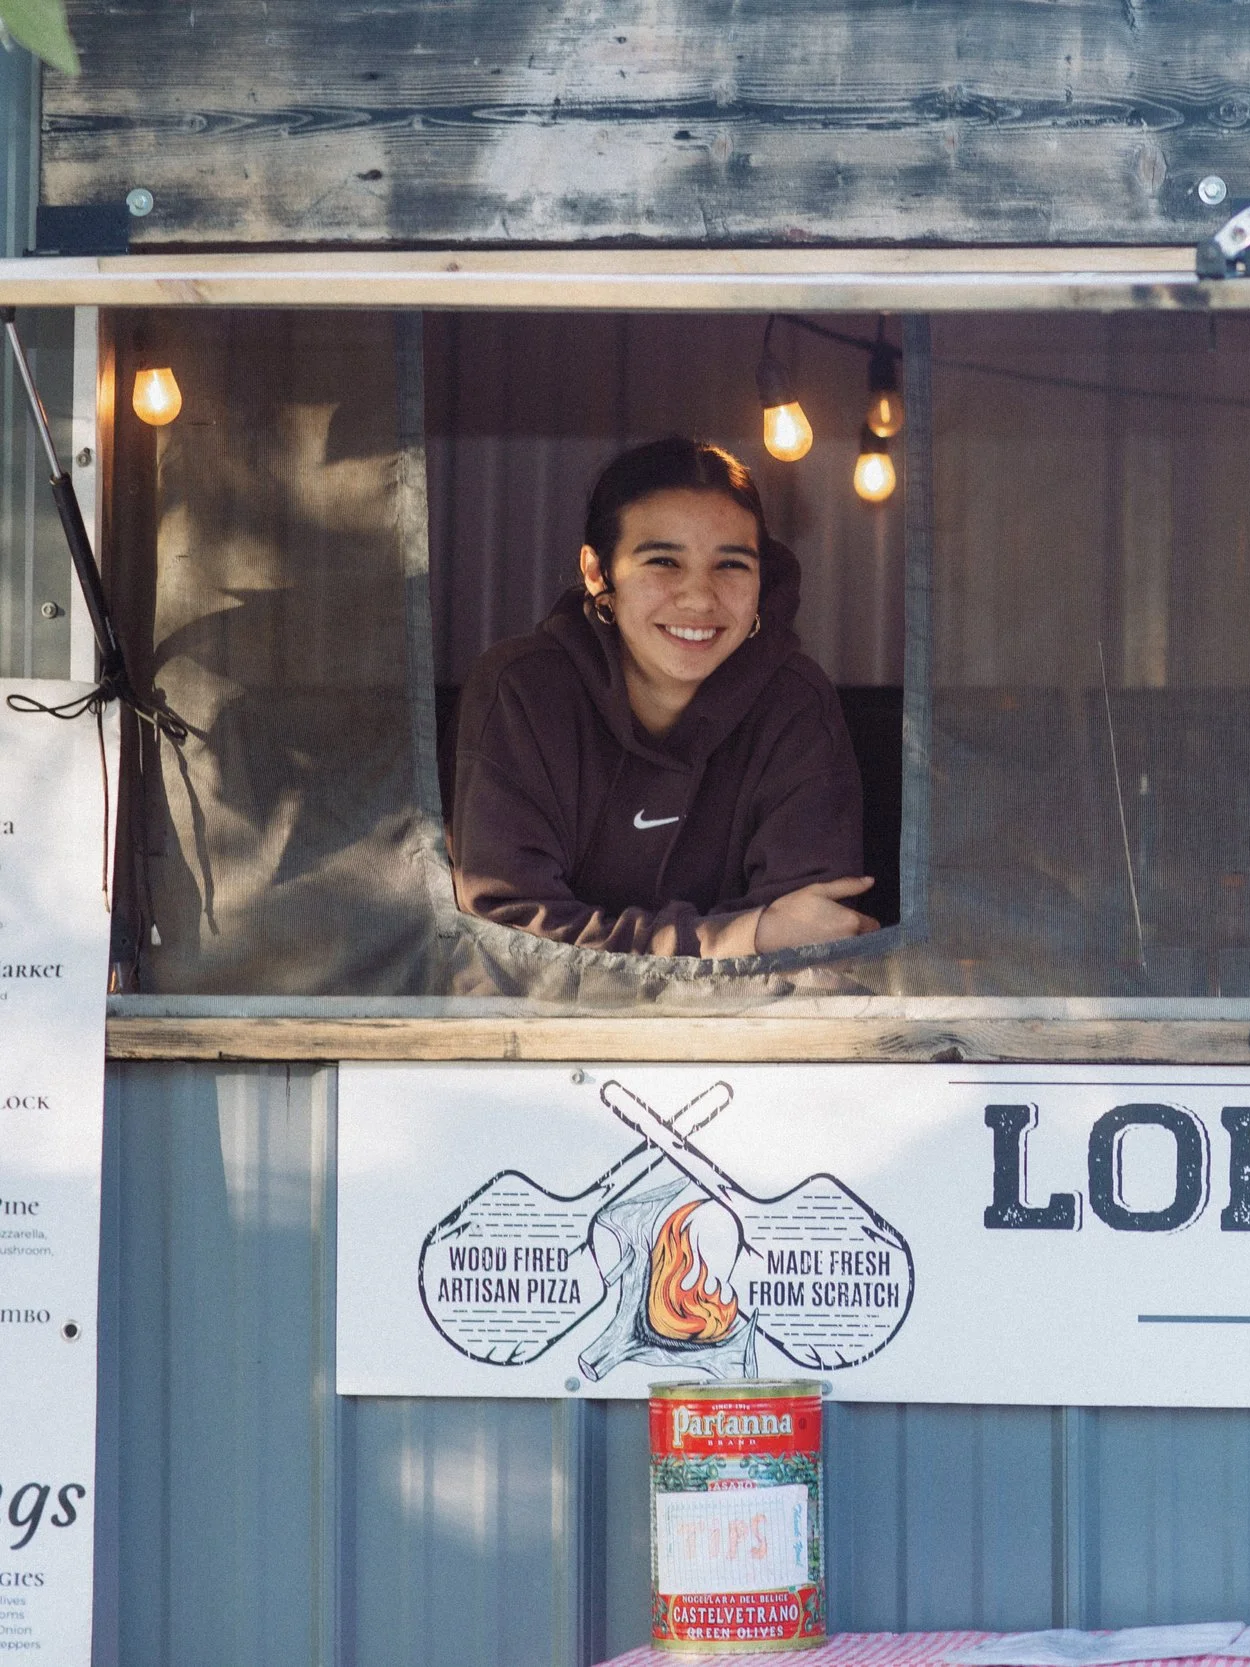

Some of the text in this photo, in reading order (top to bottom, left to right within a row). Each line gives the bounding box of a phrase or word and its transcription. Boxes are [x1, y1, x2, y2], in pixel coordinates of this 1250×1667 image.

[449, 1246, 569, 1273] WOOD FIRED
[767, 1250, 891, 1277] MADE FRESH
[438, 1277, 581, 1304] ARTISAN PIZZA
[749, 1281, 900, 1308] FROM SCRATCH
[672, 1405, 793, 1448] Partanna
[708, 1439, 757, 1447] BRAND
[740, 1594, 757, 1604] DEL
[673, 1604, 799, 1625] CASTELVETRANO
[687, 1625, 784, 1640] GREEN OLIVES
